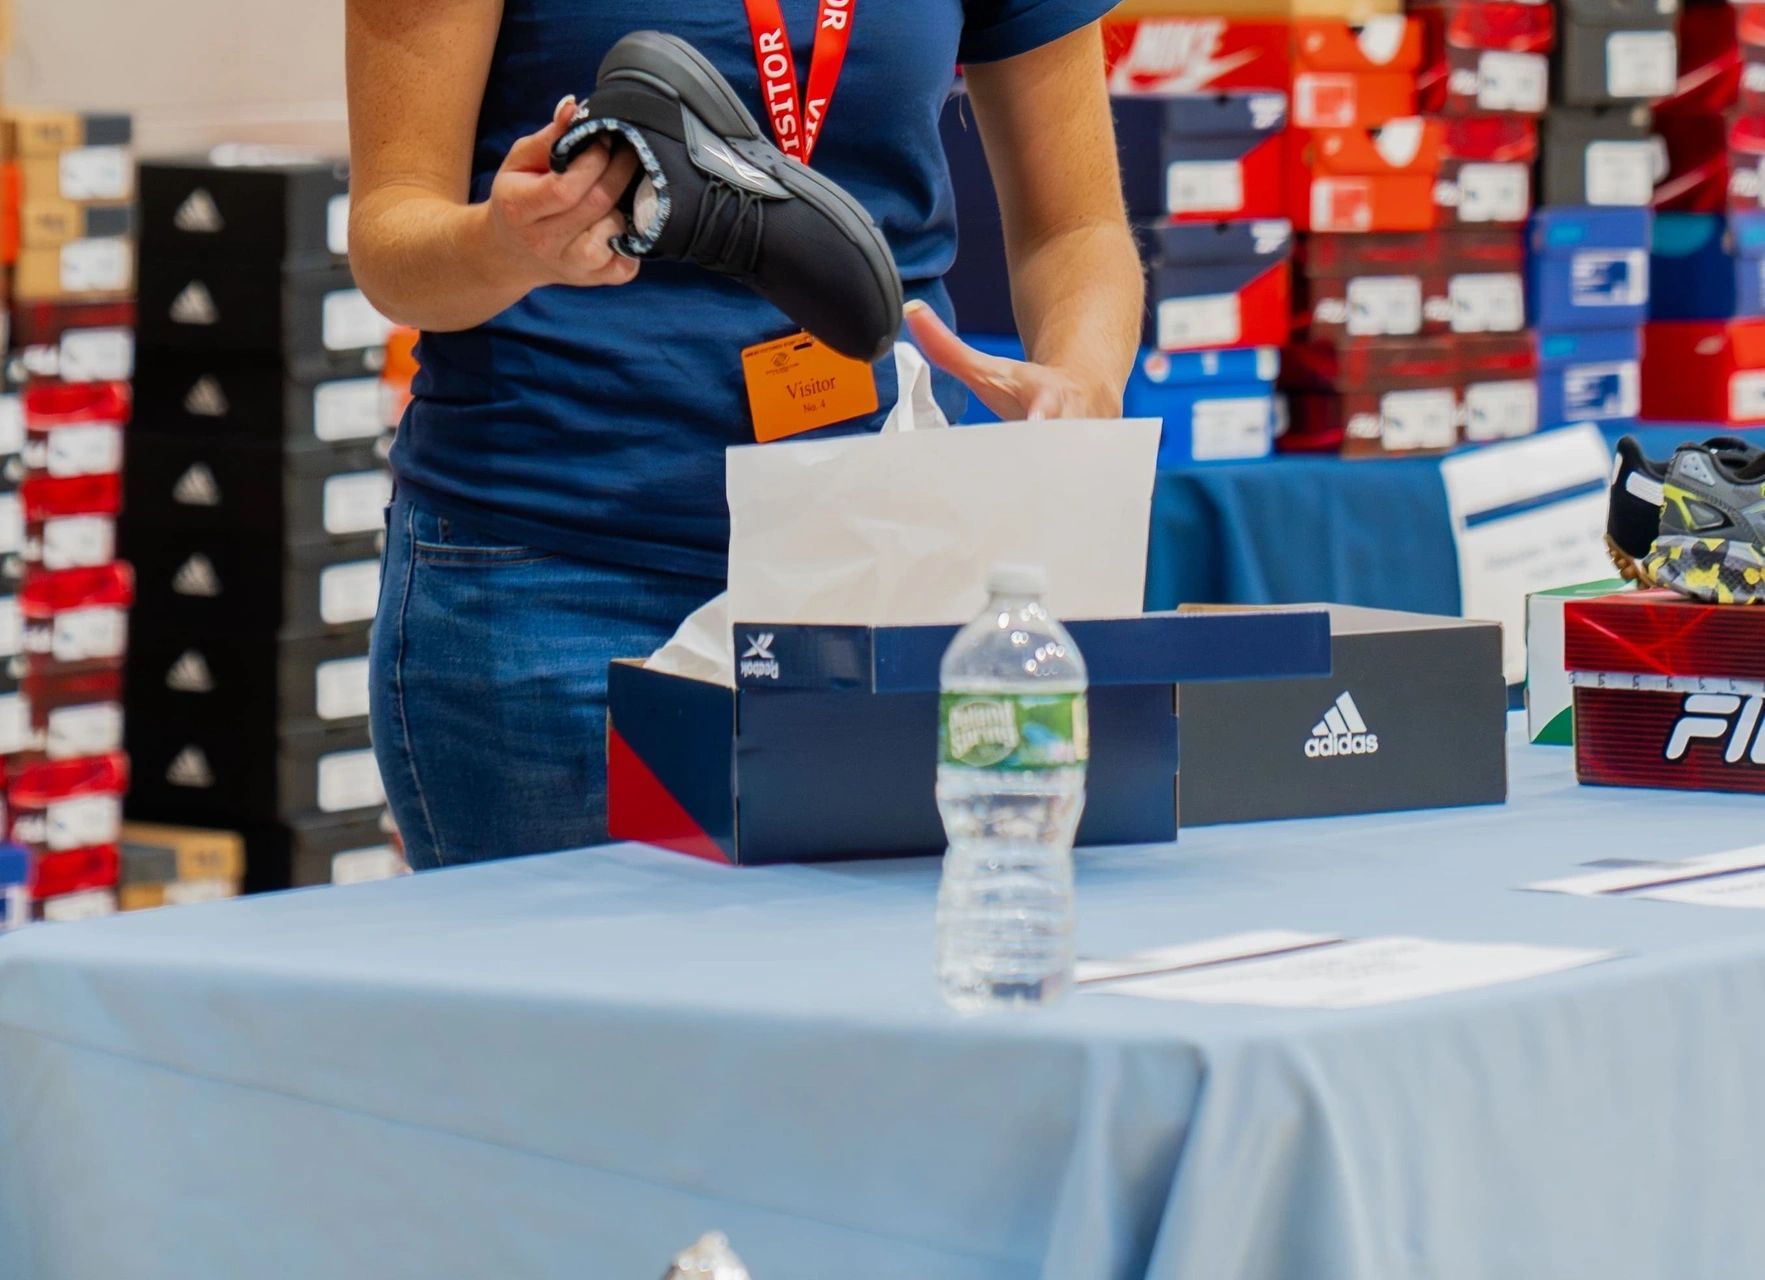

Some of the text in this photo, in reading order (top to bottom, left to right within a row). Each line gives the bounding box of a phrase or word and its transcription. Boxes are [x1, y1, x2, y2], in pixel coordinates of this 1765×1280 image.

[786, 376, 836, 399] Visitor
[1666, 694, 1765, 764] FI
[1304, 732, 1379, 758] adidas
